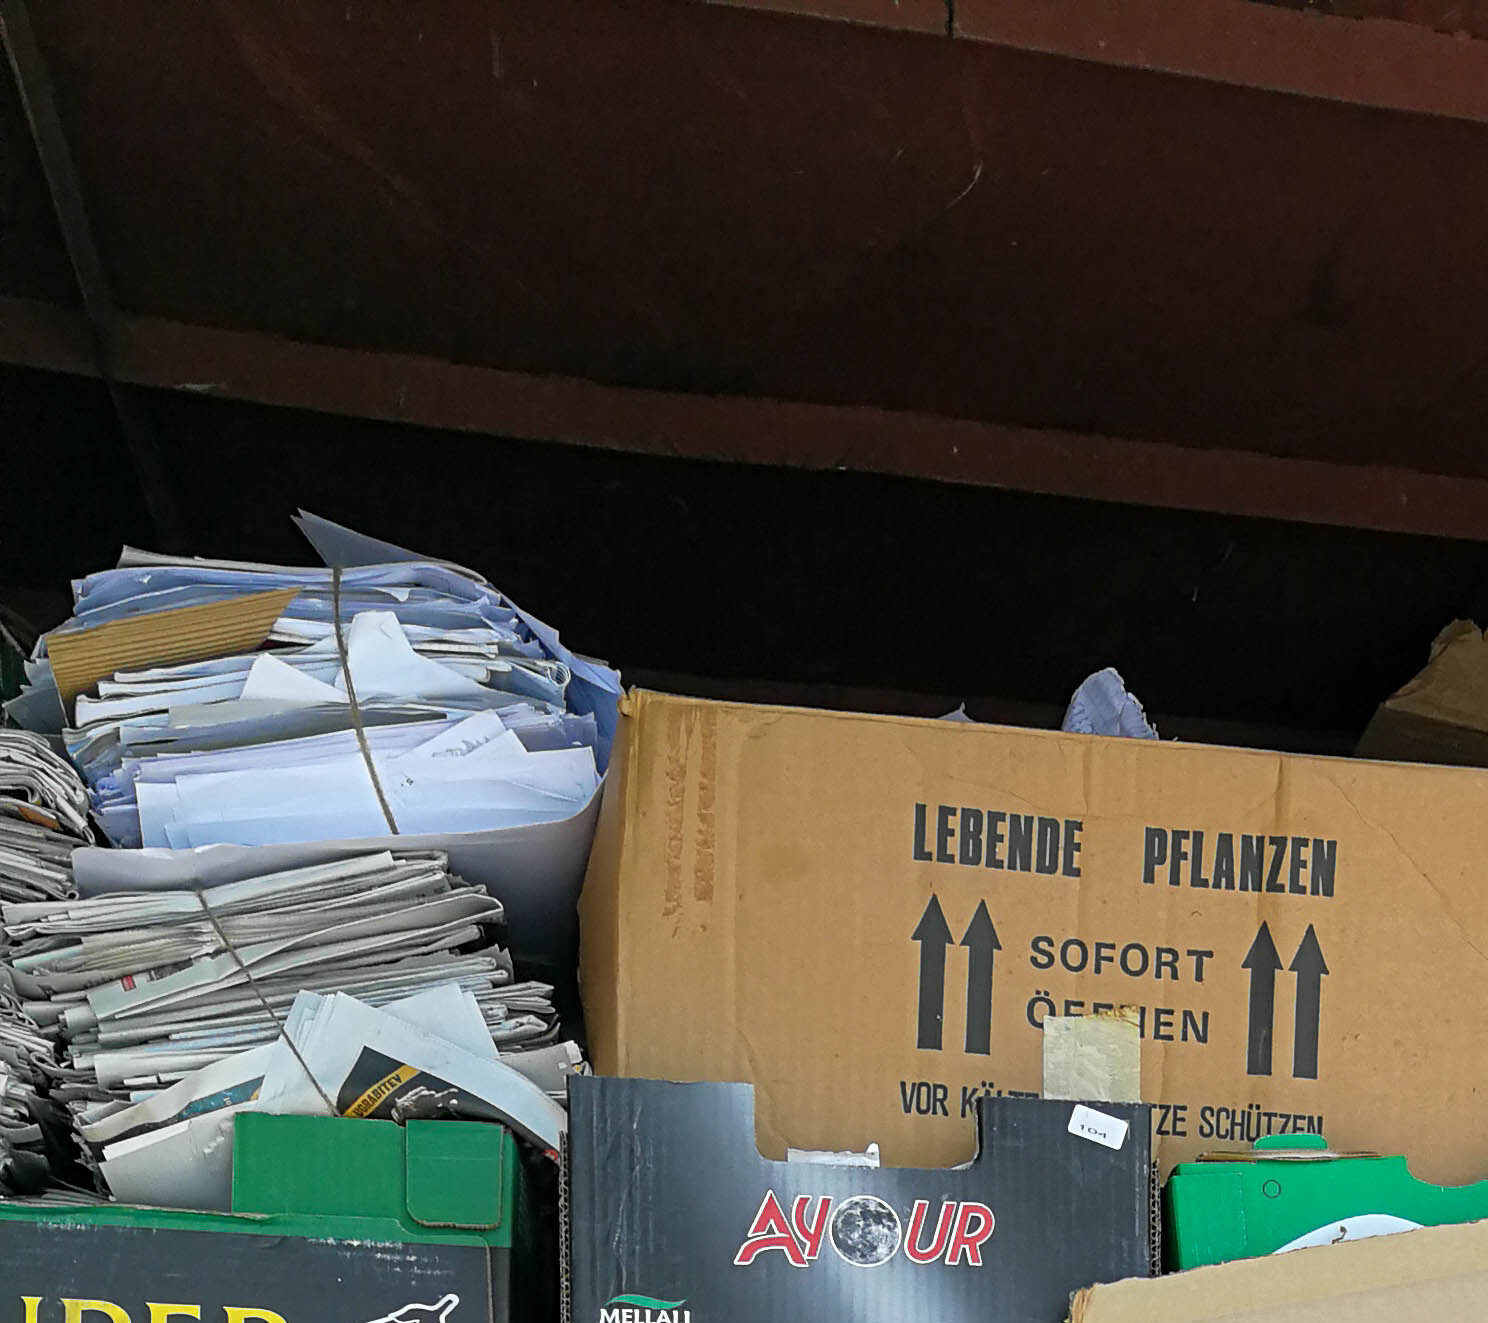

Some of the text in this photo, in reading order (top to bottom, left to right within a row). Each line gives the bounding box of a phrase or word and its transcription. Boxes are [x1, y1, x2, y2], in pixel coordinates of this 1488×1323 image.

[913, 803, 1337, 897] LEBENDE PFLANZEN
[1030, 935, 1214, 983] SOFORT
[900, 1081, 948, 1117] VOR
